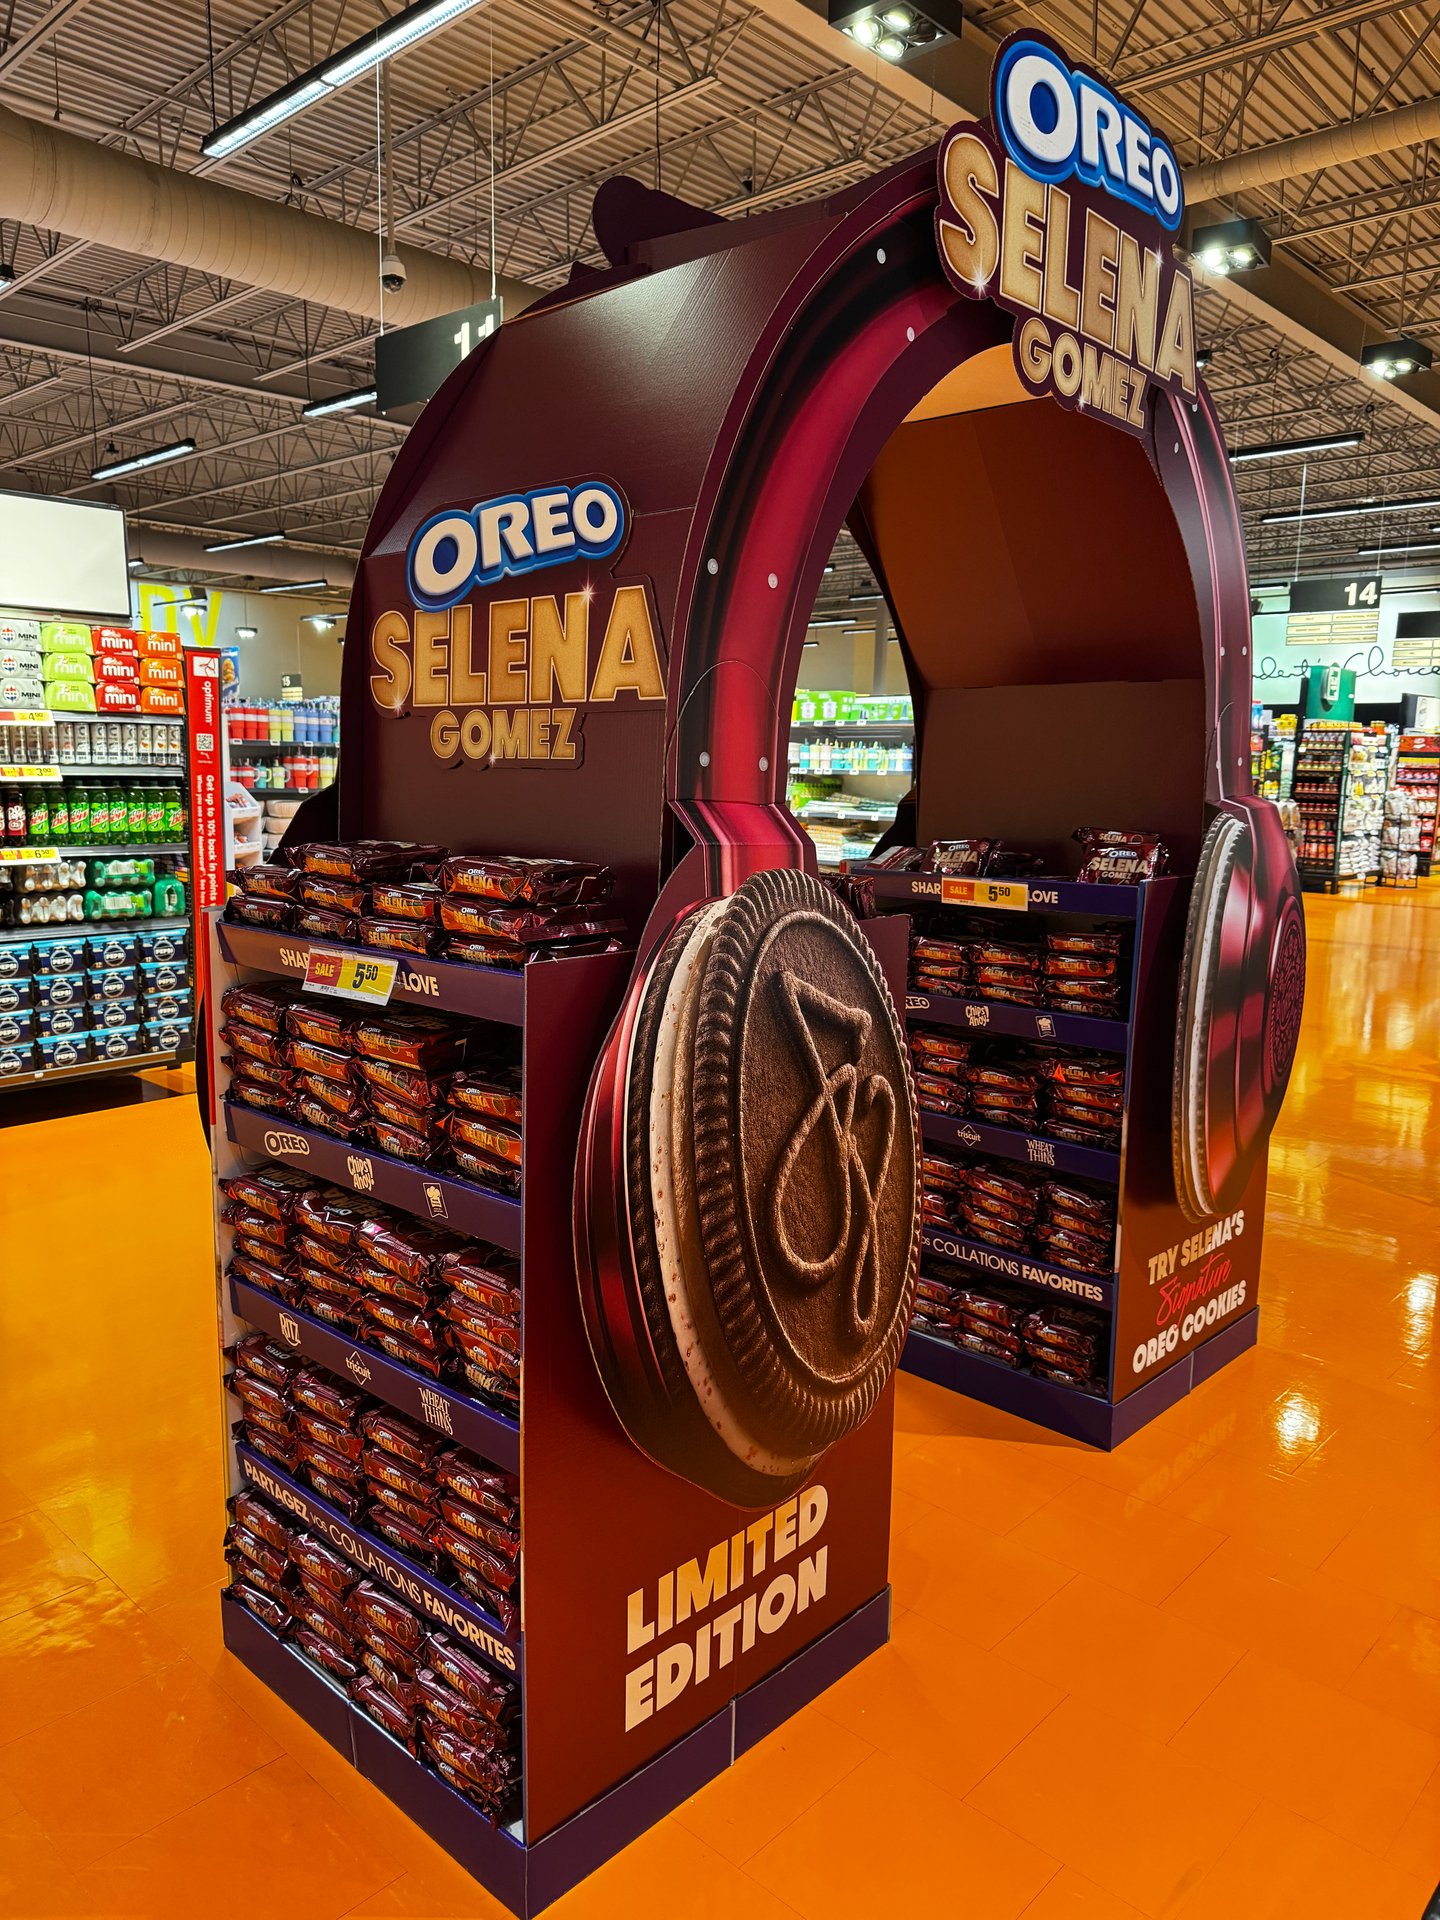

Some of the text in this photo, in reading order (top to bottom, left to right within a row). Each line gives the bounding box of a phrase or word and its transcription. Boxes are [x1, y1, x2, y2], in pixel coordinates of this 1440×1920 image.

[1006, 54, 1179, 216] OREO
[938, 131, 1198, 397] SELENA
[1018, 316, 1148, 429] GOMEZ
[414, 488, 618, 596] OREO
[1344, 581, 1379, 606] 14
[18, 632, 38, 640] MINI
[101, 636, 133, 650] mini
[147, 638, 176, 652] mini
[370, 584, 667, 710] SELENA
[102, 664, 134, 677] mini
[148, 666, 177, 680] mini
[105, 693, 136, 705] mini
[149, 693, 178, 706] mini
[202, 680, 215, 724] optimum
[429, 707, 577, 761] GOMEZ
[206, 774, 215, 791] Get
[205, 793, 214, 806] up
[207, 808, 215, 818] to
[207, 820, 216, 837] 10%
[208, 838, 217, 861] back
[932, 850, 979, 864] SELENA
[948, 843, 970, 852] OREO
[1108, 849, 1137, 858] OREO
[1089, 855, 1149, 874] SELENA
[1101, 870, 1132, 880] GOMEZ
[208, 873, 219, 904] points
[456, 872, 495, 890] SELENA
[950, 885, 968, 896] SALE
[379, 894, 409, 912] SELENA
[1027, 889, 1059, 904] LOVE
[453, 910, 486, 928] SELENA
[367, 931, 397, 945] SELENA
[461, 948, 494, 965] SELENA
[314, 962, 335, 978] SALE
[402, 971, 440, 997] LOVE
[965, 1005, 986, 1018] Chips
[969, 1010, 990, 1027] Ahoy!
[365, 1063, 393, 1082] SELENA
[458, 1092, 490, 1110] SELENA
[265, 1131, 310, 1157] OREO
[464, 1126, 493, 1148] SELENA
[957, 1128, 982, 1142] triscuit
[1025, 1139, 1055, 1155] WHEAT
[1027, 1148, 1055, 1167] THINS
[346, 1154, 369, 1176] Chips
[353, 1164, 376, 1192] Ahoy!
[1148, 1209, 1245, 1286] TRY SELENA'S
[932, 1237, 1019, 1276] COLLATIONS
[1021, 1264, 1104, 1302] FAVORITES
[454, 1280, 487, 1304] SELENA
[278, 1312, 302, 1346] RITZ
[461, 1318, 495, 1342] SELENA
[1132, 1279, 1247, 1374] OREO COOKIES
[345, 1357, 372, 1381] triscuit
[418, 1387, 451, 1412] WHEAT
[421, 1404, 454, 1436] THINS
[378, 1467, 409, 1492] SELENA
[447, 1476, 479, 1503] SELENA
[452, 1512, 485, 1540] SELENA
[242, 1458, 310, 1523] PARTAGEZ
[329, 1523, 422, 1605] COLLATIONS
[424, 1589, 517, 1672] FAVORITES
[446, 1542, 477, 1570] SELENA
[626, 1483, 829, 1656] LIMITED
[624, 1544, 829, 1734] EDITION
[436, 1660, 465, 1691] SELENA
